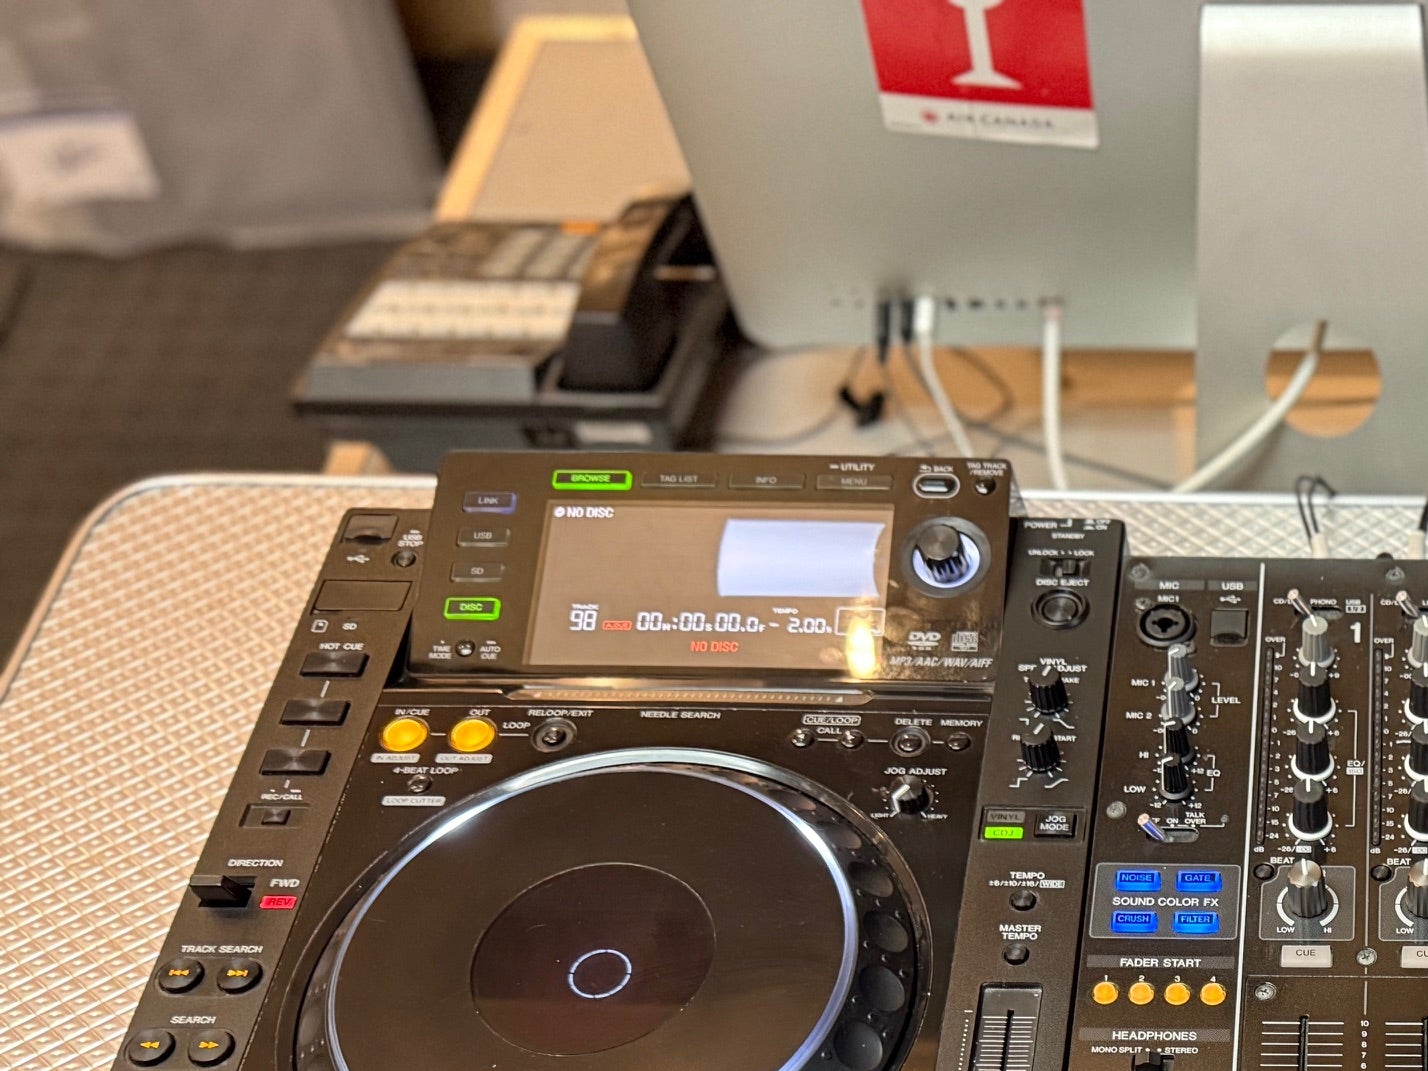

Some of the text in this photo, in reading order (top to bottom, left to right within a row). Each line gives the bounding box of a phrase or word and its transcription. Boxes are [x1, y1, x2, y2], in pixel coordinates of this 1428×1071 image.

[841, 463, 875, 471] UTILITY
[660, 475, 698, 483] TAG LIST
[567, 507, 614, 518] NO DISC
[1060, 579, 1089, 587] EJECT
[1159, 582, 1179, 590] MIC
[1221, 582, 1243, 590] USB
[460, 603, 482, 611] DISC
[570, 611, 597, 631] 98
[1350, 622, 1361, 643] 1
[691, 641, 738, 651] NO DISC
[641, 711, 678, 719] NEEDLE
[941, 719, 983, 727] MEMORY
[817, 727, 841, 735] CALL
[884, 767, 947, 776] JOG ADJUST
[1045, 815, 1066, 823] JOG
[1040, 823, 1069, 831] MODE
[228, 859, 283, 867] DIRECTION
[1010, 872, 1045, 880] TEMPO
[1122, 874, 1151, 882] NOISE
[1185, 874, 1211, 882] GATE
[270, 879, 300, 887] FWD
[1113, 897, 1219, 906] SOUND COLOR FX
[1118, 915, 1149, 923] CRUSH
[999, 924, 1041, 933] MASTER
[1002, 932, 1037, 940] TEMPO
[181, 945, 263, 954] TRACK SEARCH
[1120, 958, 1201, 967] FADER START
[170, 1016, 215, 1024] SEARCH
[1112, 1031, 1197, 1040] HEADPHONES
